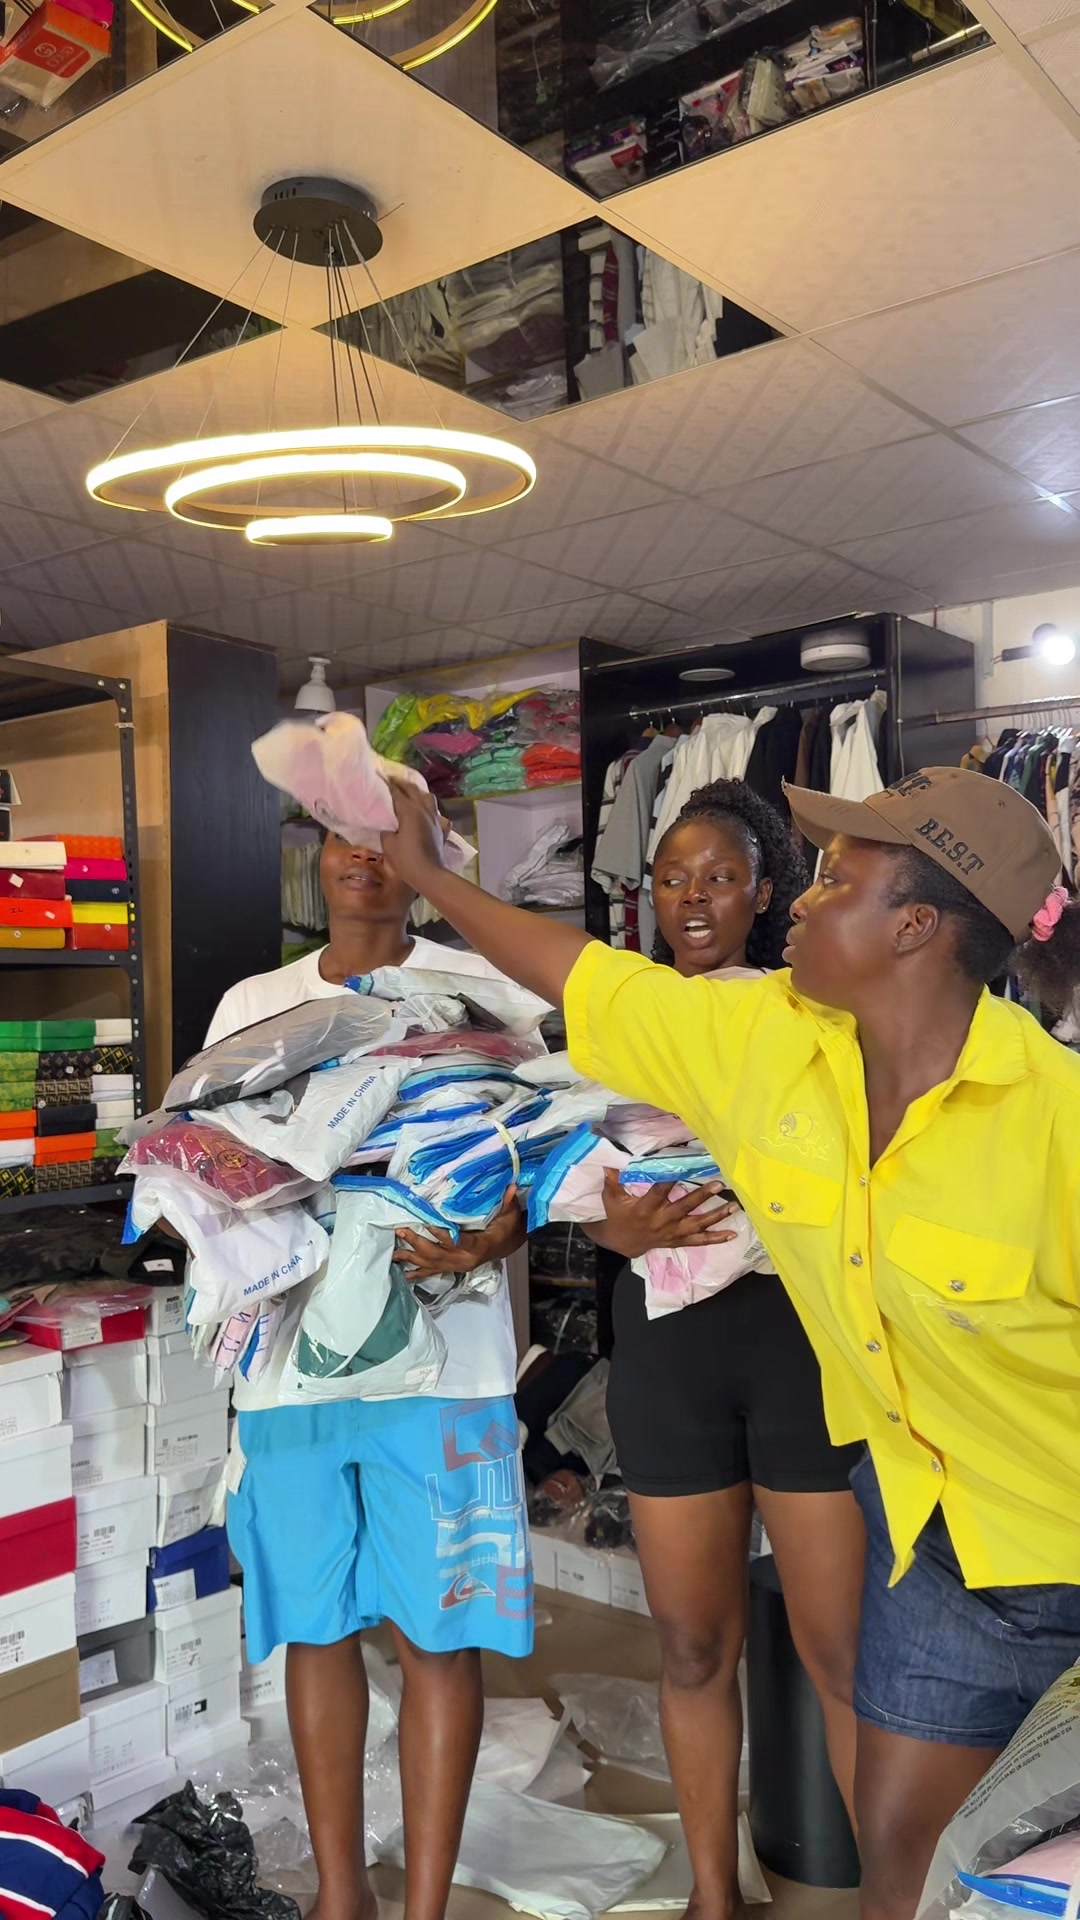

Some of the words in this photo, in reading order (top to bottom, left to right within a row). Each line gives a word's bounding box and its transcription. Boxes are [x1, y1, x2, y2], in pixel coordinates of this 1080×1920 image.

[914, 817, 985, 876] B.E.S.T
[327, 1106, 350, 1129] MADE
[345, 1097, 357, 1108] IN
[353, 1075, 378, 1098] CHINA
[243, 1276, 270, 1296] MADE
[271, 1269, 280, 1281] IN
[280, 1254, 303, 1275] CHNA
